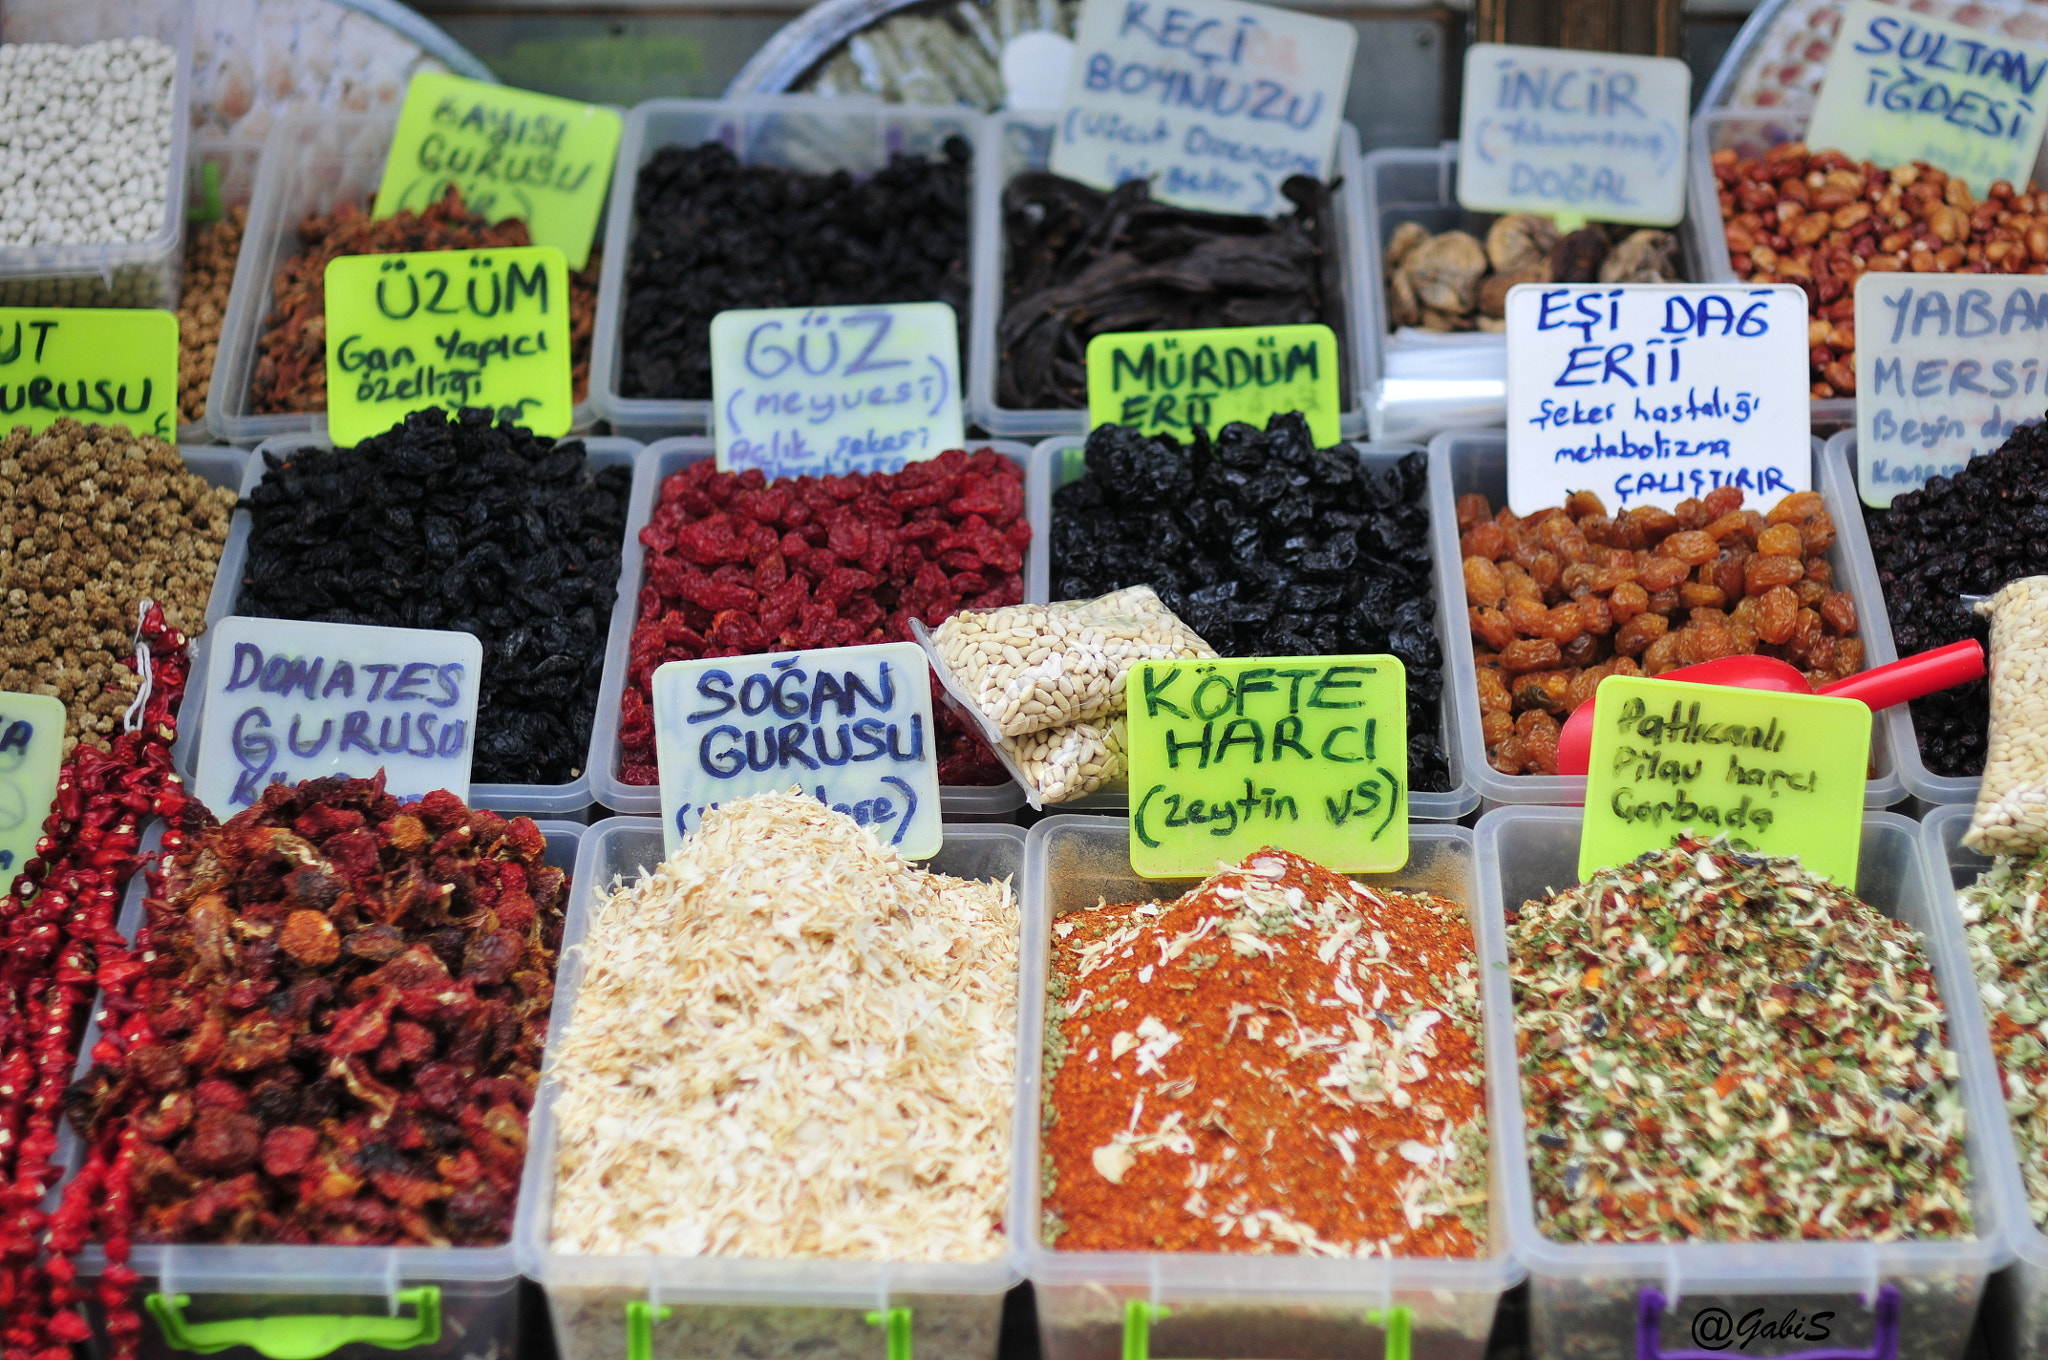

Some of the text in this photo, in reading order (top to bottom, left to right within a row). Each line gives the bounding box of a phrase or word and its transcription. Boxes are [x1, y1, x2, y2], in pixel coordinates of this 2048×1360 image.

[1854, 17, 2048, 96] SULTAN
[1084, 52, 1324, 130] BOYNUZU
[1494, 59, 1648, 118] İNCİR
[1509, 161, 1641, 204] DOĞAL
[376, 256, 549, 320] ÜZÜM
[1537, 289, 1624, 343] EŞİ
[744, 310, 912, 379] GÜZ
[1112, 336, 1319, 392] MÜRDÜM
[1634, 386, 1760, 423] hastalığı
[1874, 357, 2048, 399] MERSİ
[1555, 430, 1731, 463] metabolizma
[225, 642, 464, 708] DOMATES
[687, 655, 896, 724] SOĞAN
[1143, 664, 1377, 720] KÖFTE
[232, 707, 467, 772] GURUSU
[699, 712, 925, 779] GURUSU
[1166, 716, 1376, 769] HARCI
